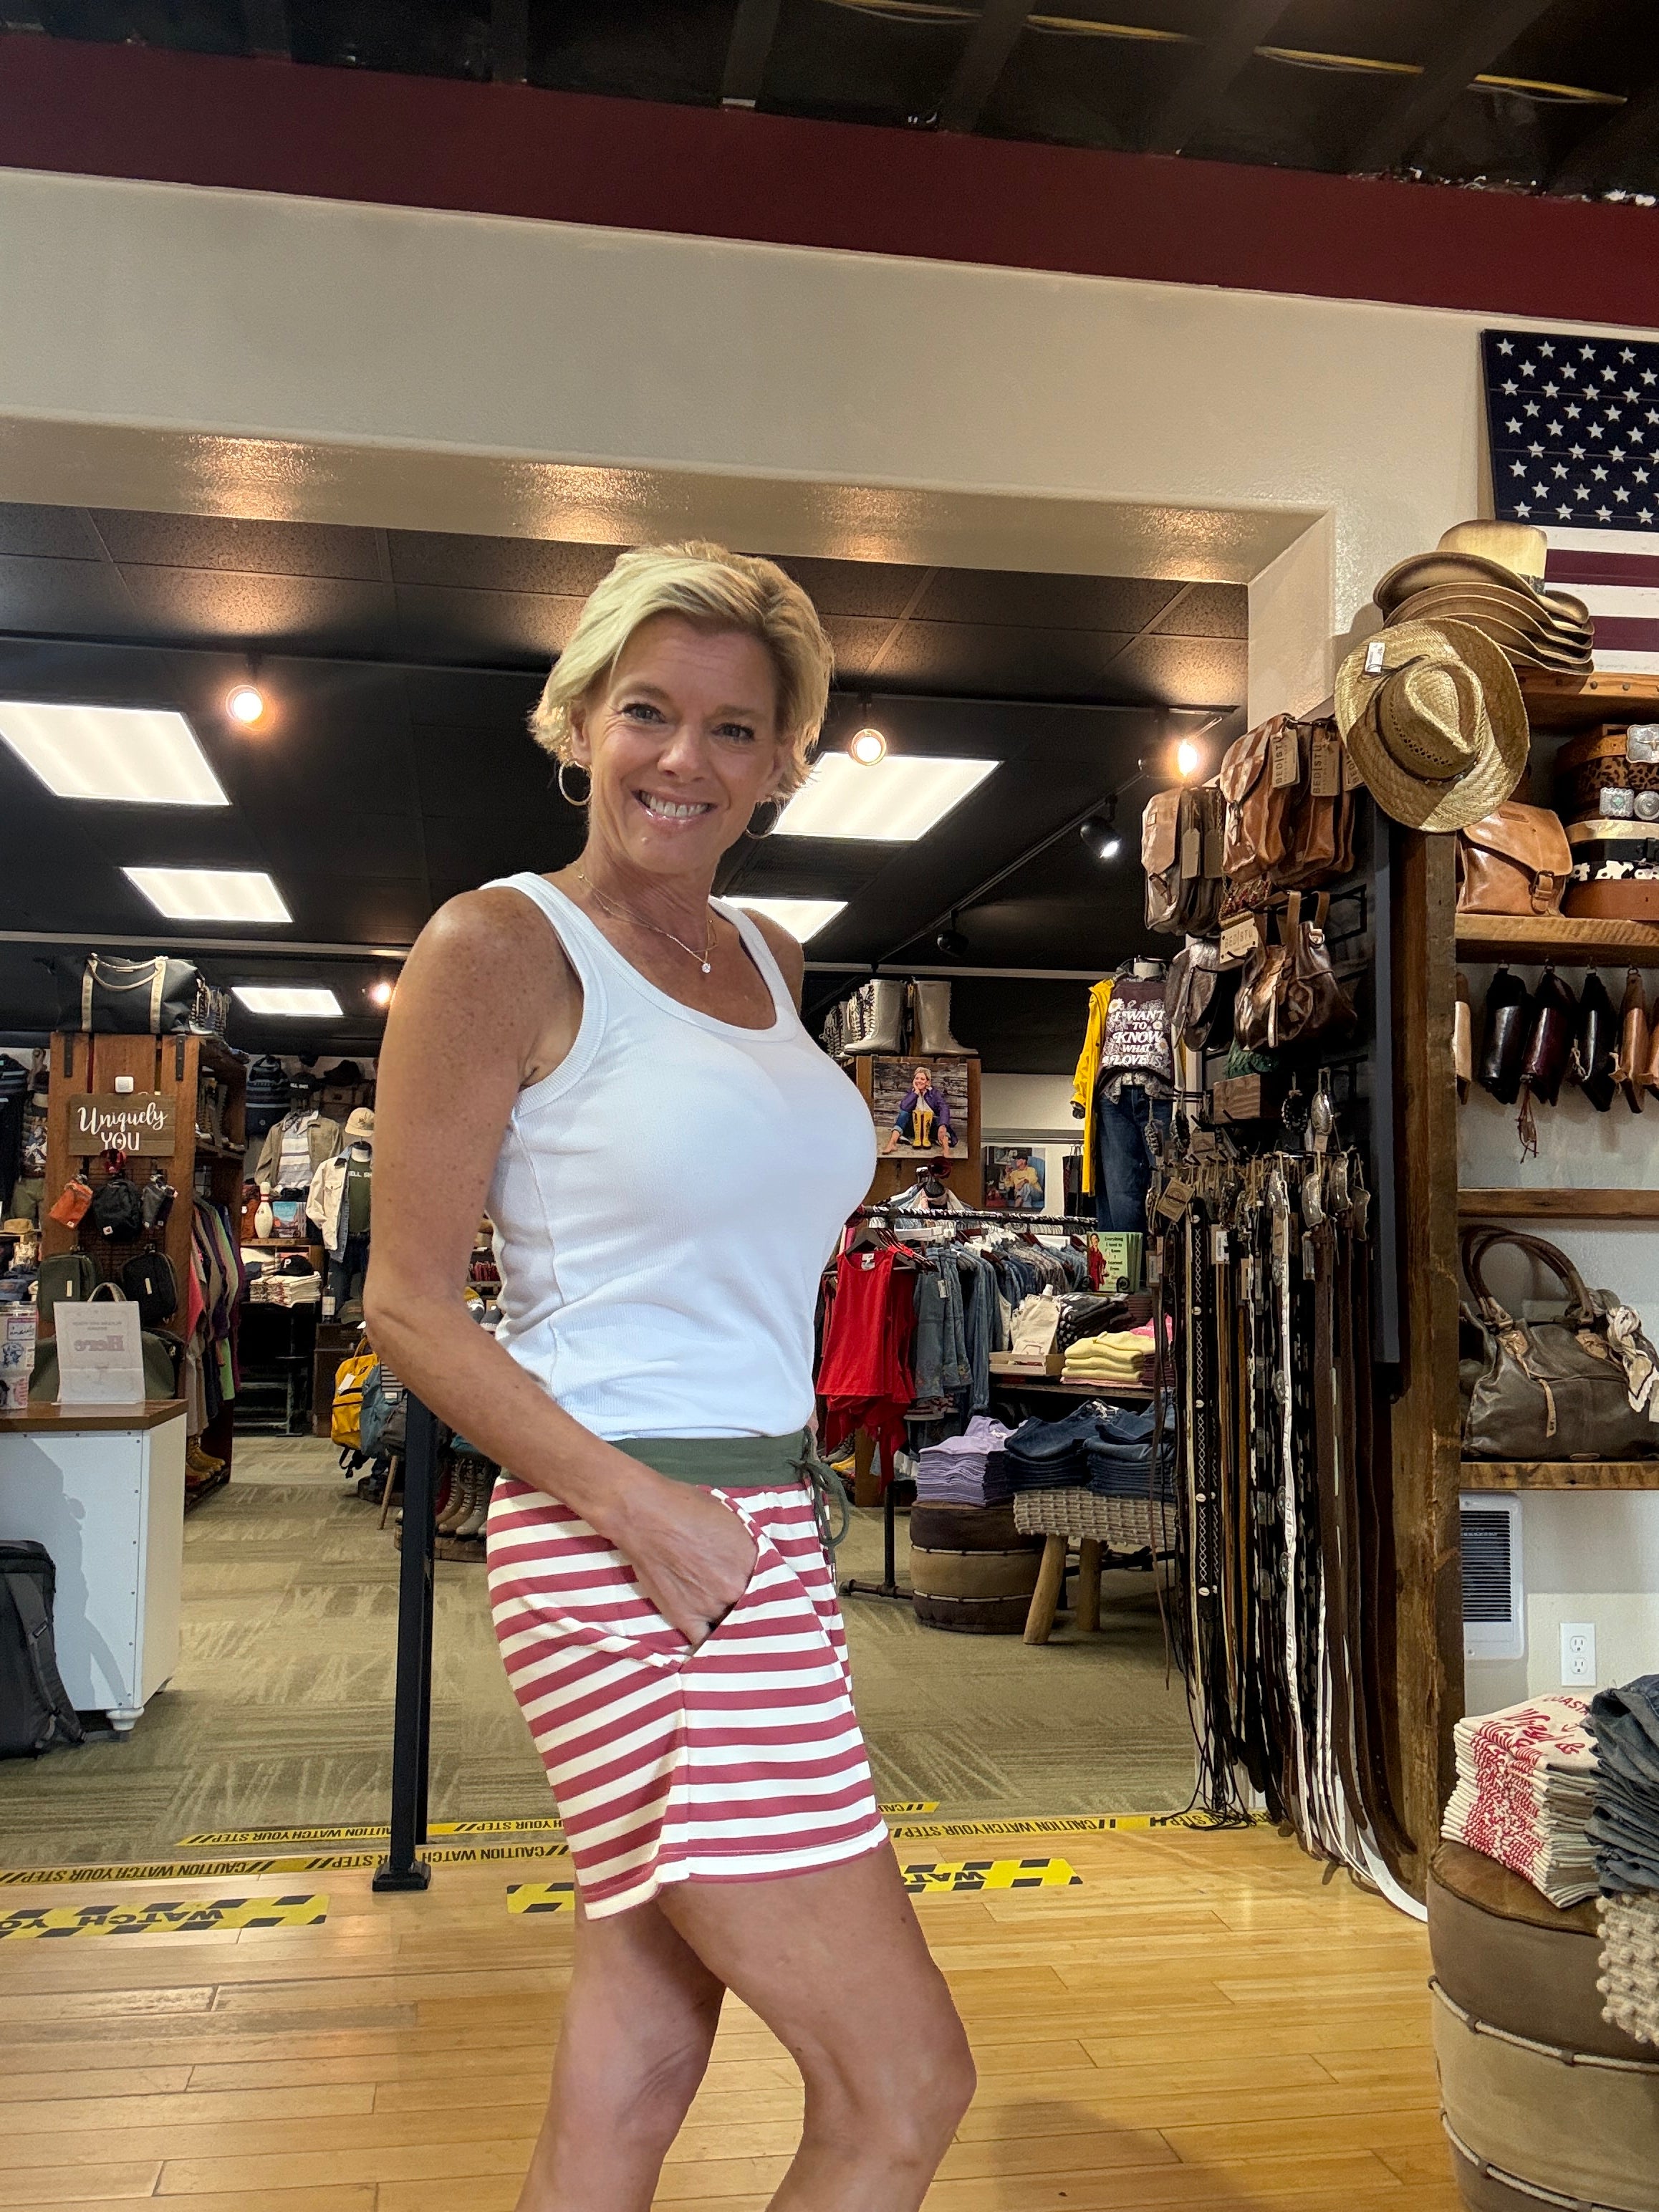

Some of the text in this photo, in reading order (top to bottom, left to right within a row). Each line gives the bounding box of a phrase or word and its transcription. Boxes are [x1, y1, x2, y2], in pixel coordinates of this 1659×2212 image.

[1122, 1011, 1165, 1022] WANT
[1132, 1021, 1147, 1030] TO
[1112, 1031, 1164, 1044] KNOW
[1122, 1044, 1152, 1053] WHAT
[77, 1102, 169, 1135] Uniquely
[101, 1132, 140, 1151] YOU
[284, 1259, 292, 1269] P
[477, 1822, 512, 1832] STEP
[516, 1820, 552, 1829] YOUR
[905, 1819, 1097, 1838] CAUTION WATCH YOUR STEP
[212, 1833, 249, 1843] STEP
[252, 1831, 288, 1841] YOUR
[292, 1829, 341, 1840] WATCH
[422, 1846, 544, 1863] CAUTION WATCH
[332, 1855, 374, 1867] STEP
[21, 1862, 246, 1883] CAUTION WATCH YOUR STEP
[0, 1909, 223, 1930] WATCH YO
